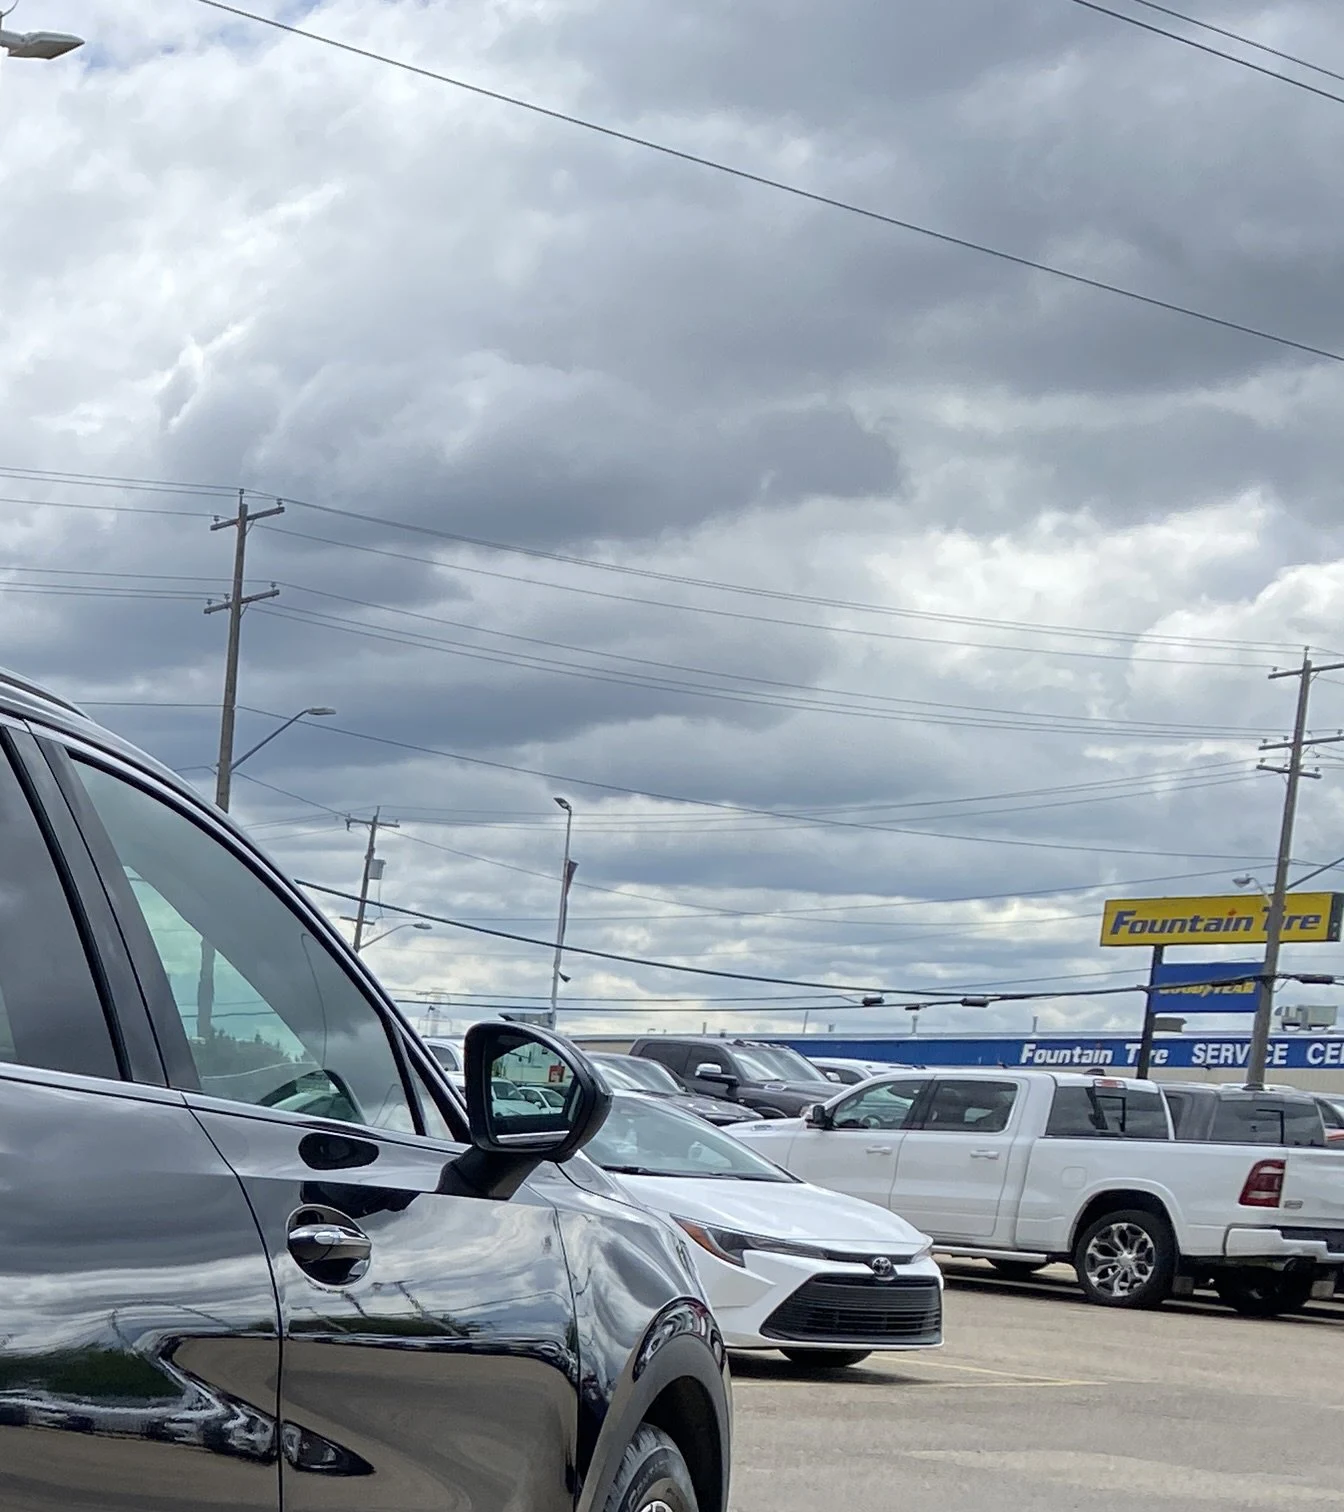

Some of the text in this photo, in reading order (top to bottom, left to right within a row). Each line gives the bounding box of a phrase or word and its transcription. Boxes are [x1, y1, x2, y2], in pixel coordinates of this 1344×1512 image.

[1110, 906, 1322, 936] Fountain Tre
[1020, 1042, 1344, 1065] Fountain Tre SERVE CE
